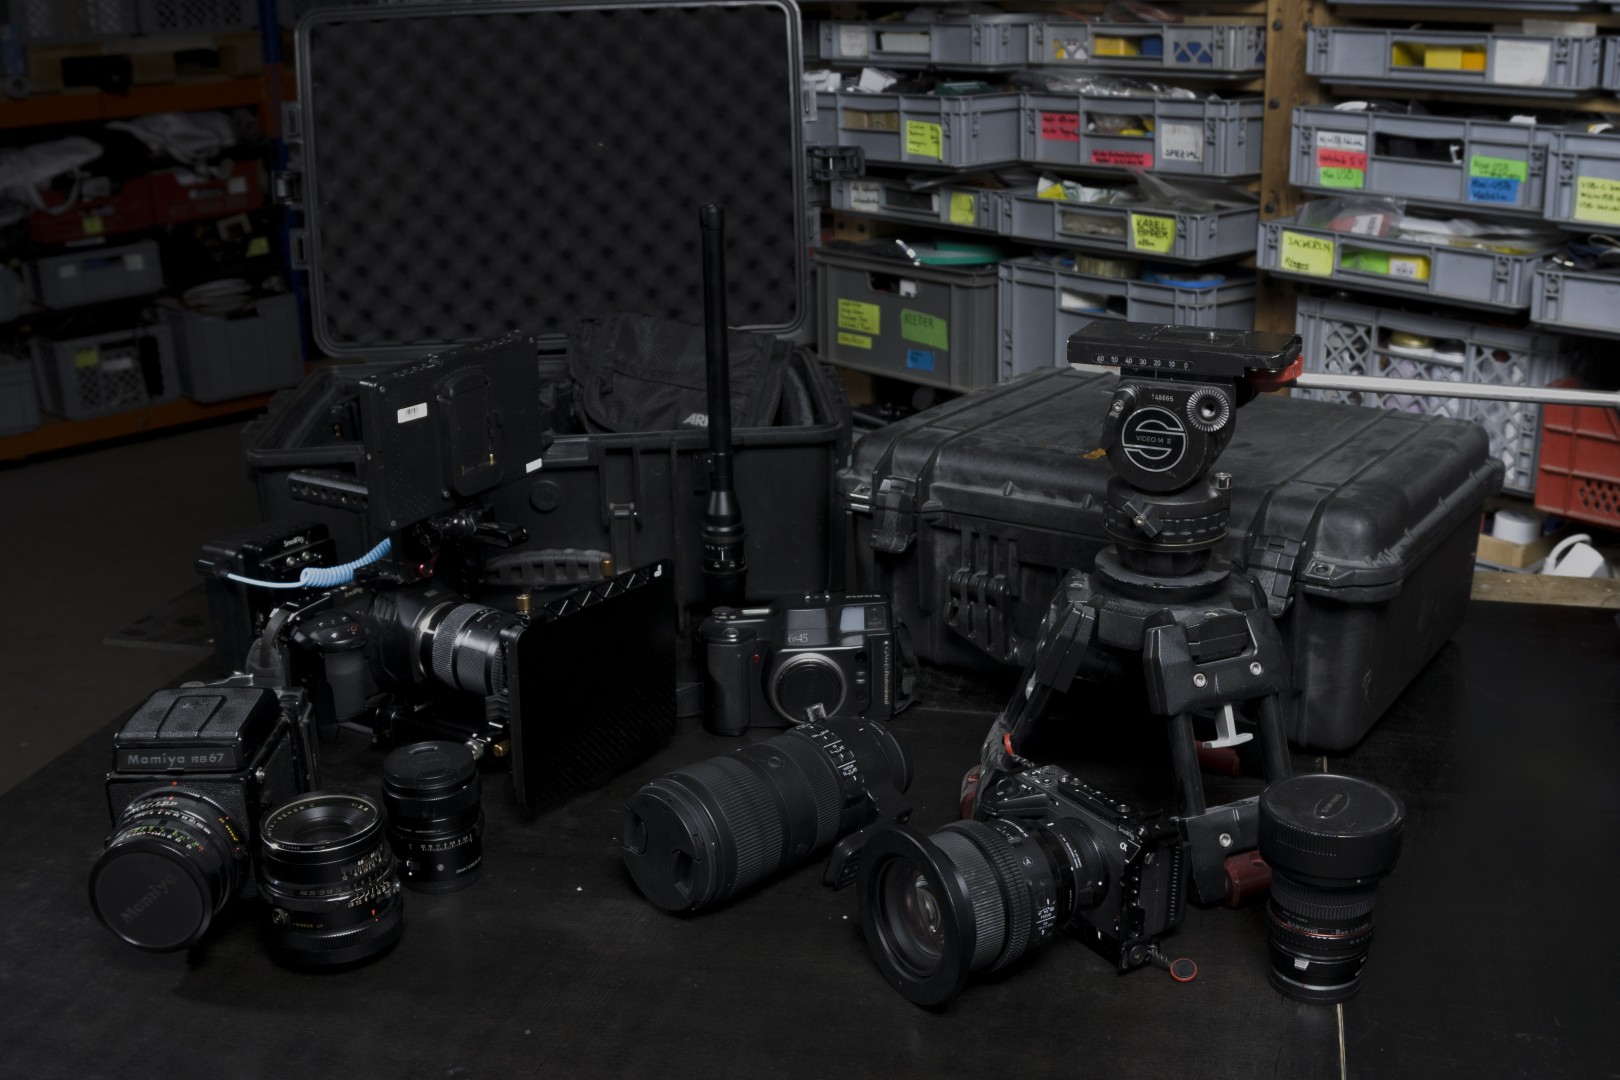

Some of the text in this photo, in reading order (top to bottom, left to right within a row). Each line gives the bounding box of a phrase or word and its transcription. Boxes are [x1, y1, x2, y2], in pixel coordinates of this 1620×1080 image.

[1153, 359, 1161, 367] 20
[1135, 435, 1156, 443] VIDEO
[128, 753, 224, 767] Mamiya RB67
[121, 873, 177, 924] Mamiya
